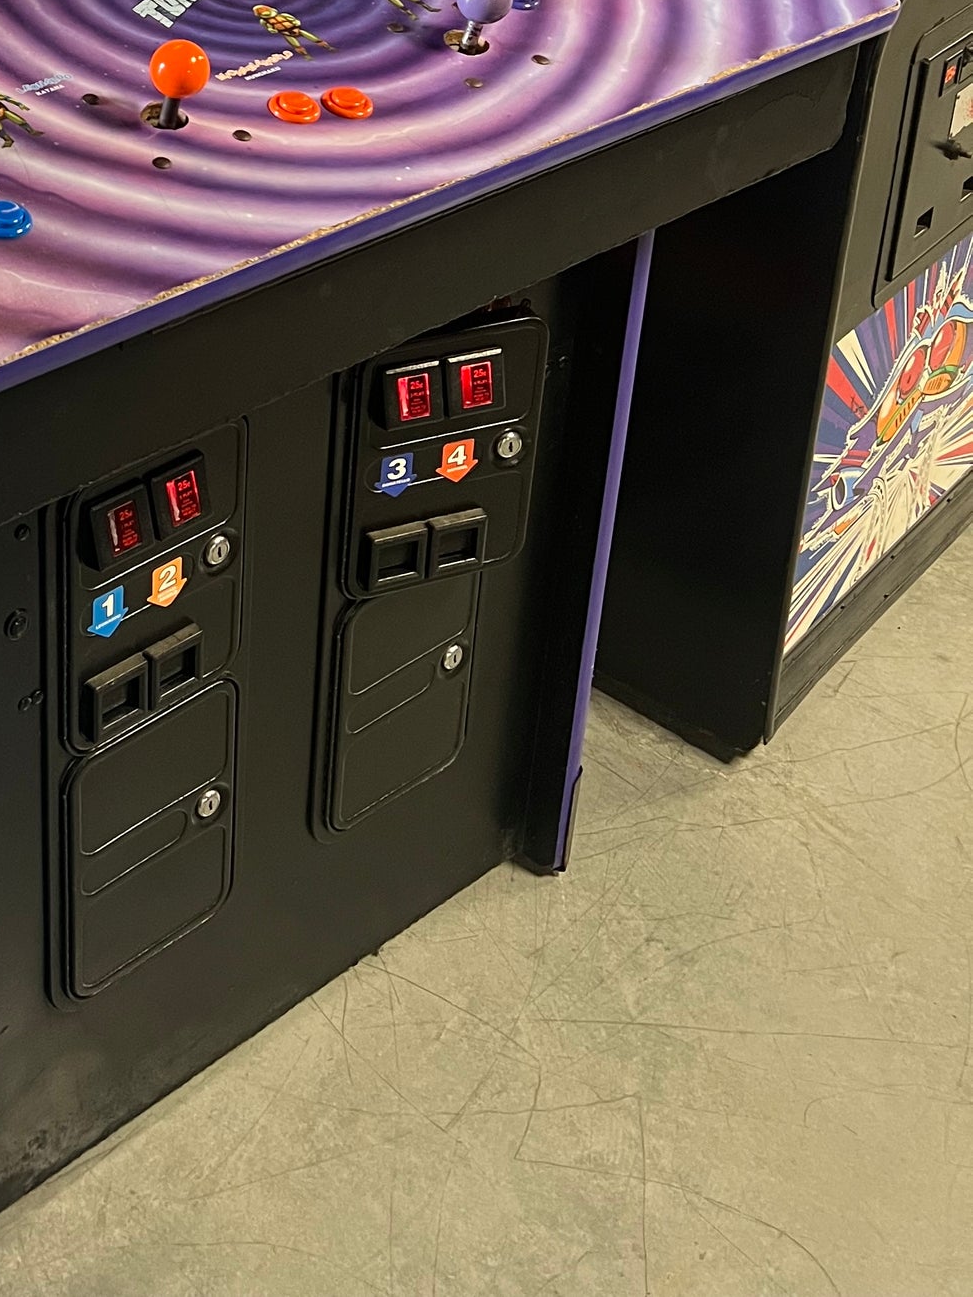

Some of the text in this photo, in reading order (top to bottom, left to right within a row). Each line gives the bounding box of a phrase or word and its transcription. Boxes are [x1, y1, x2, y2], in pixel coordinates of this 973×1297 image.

[447, 445, 467, 466] 4
[387, 458, 407, 480] 3
[158, 565, 177, 592] 2
[101, 594, 114, 618] 1
